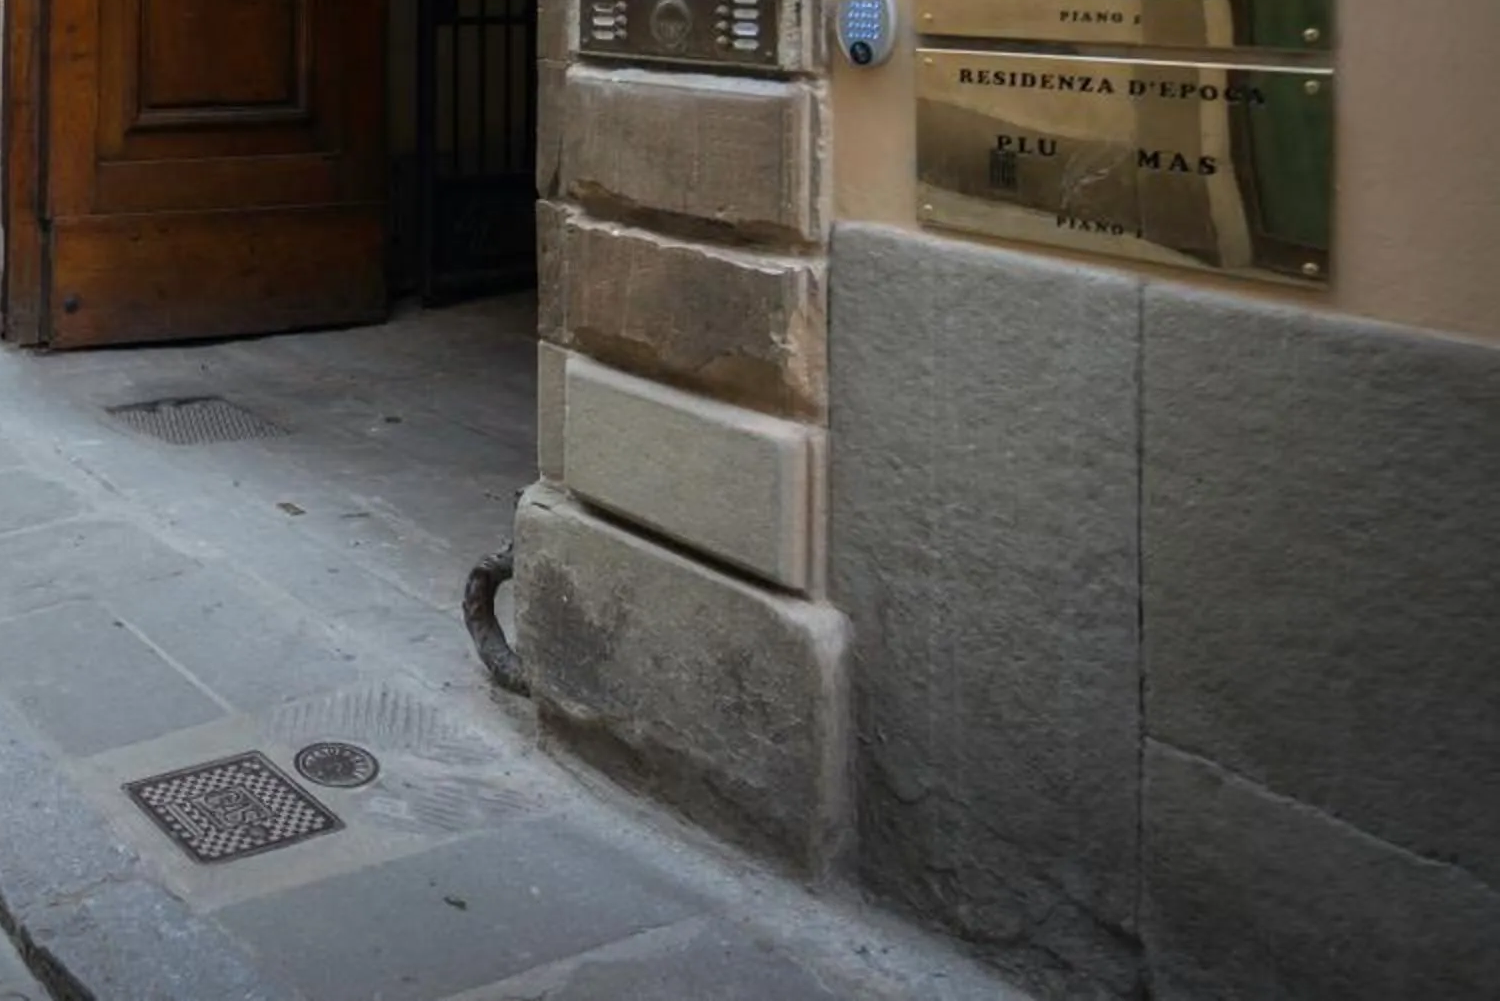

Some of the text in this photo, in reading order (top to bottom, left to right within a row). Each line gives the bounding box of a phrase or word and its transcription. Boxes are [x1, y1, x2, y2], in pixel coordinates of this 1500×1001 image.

[1060, 10, 1124, 24] PIANO
[959, 68, 1266, 104] RESIDENZA D'EPOCA
[1056, 214, 1124, 236] PIANO
